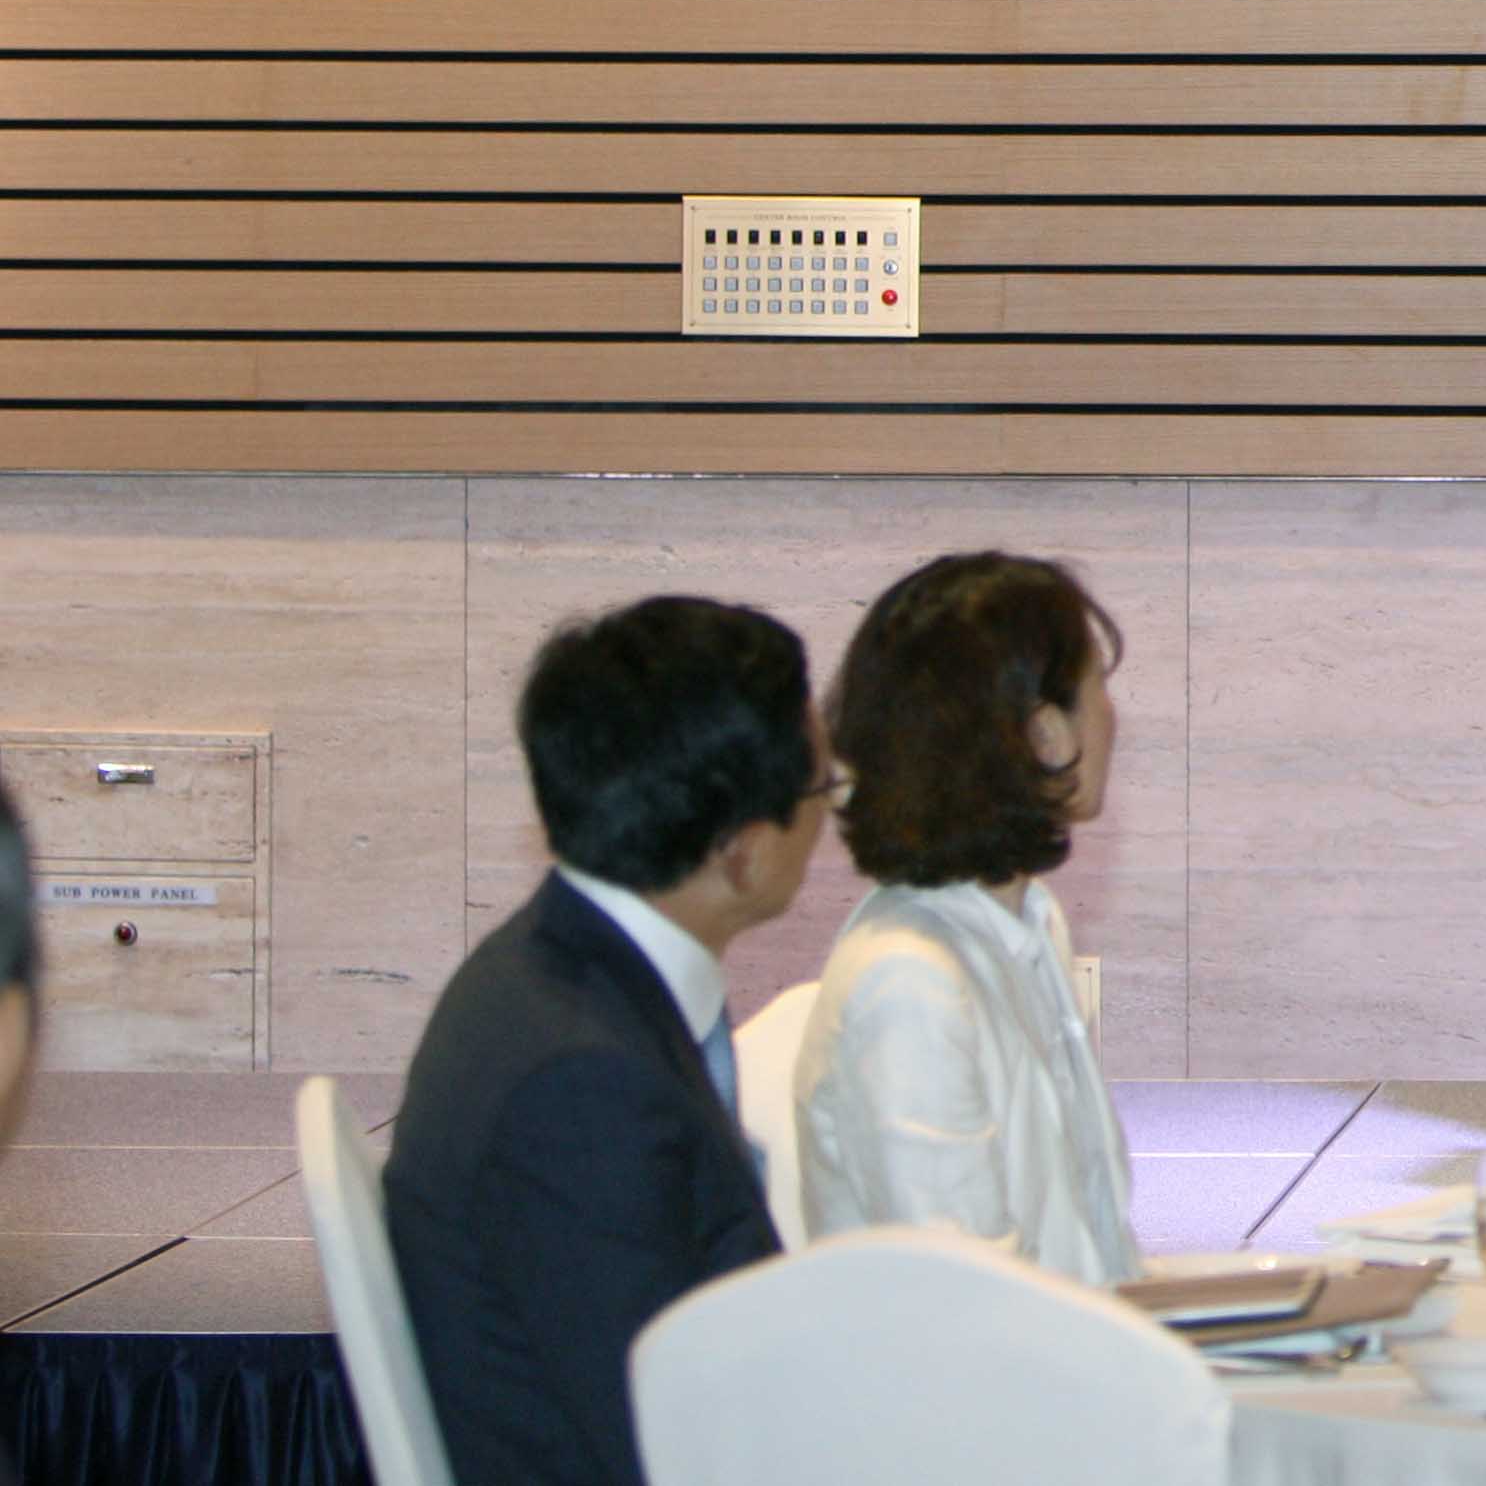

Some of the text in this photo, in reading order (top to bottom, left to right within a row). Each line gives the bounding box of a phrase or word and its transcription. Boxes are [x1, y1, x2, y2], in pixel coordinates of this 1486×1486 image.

[53, 886, 199, 900] SUB POWER PANEL
